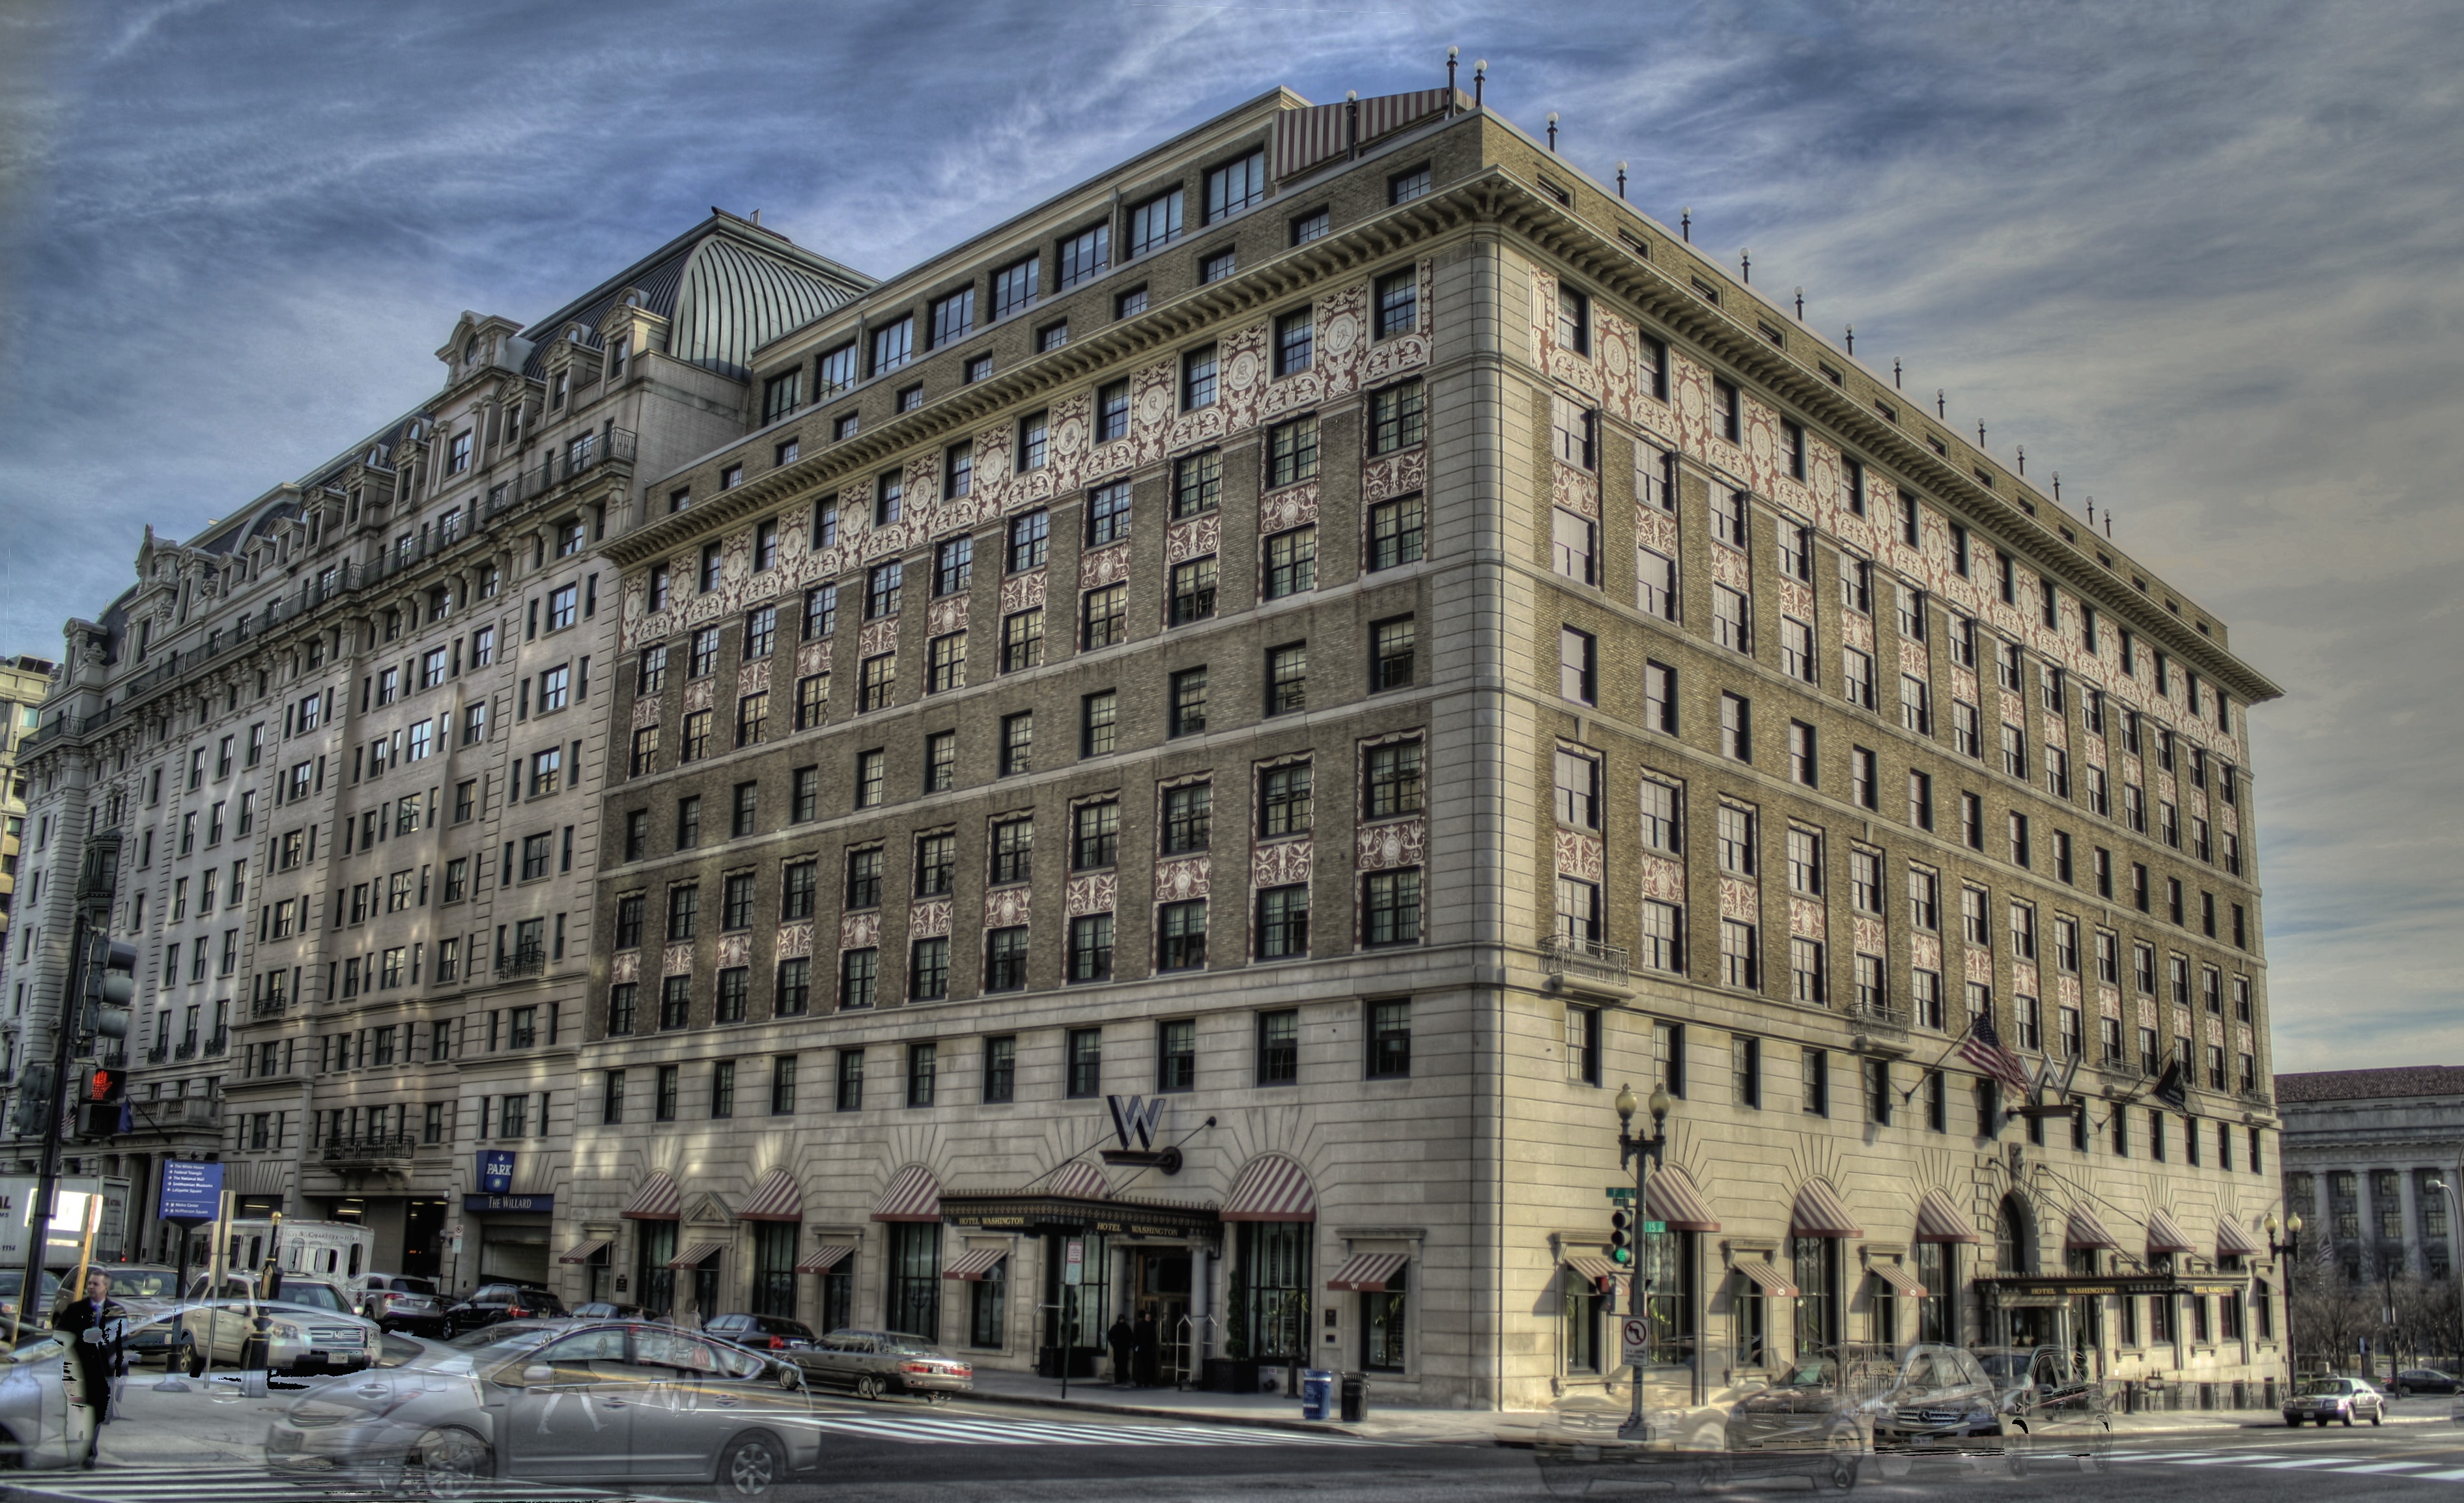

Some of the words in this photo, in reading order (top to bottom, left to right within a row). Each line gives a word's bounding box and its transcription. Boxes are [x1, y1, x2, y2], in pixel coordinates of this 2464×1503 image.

[2017, 1052, 2081, 1102] W
[1107, 1095, 1166, 1148] W
[487, 1163, 512, 1175] PARK
[1613, 1188, 1619, 1197] F
[489, 1196, 501, 1208] THE
[502, 1196, 531, 1209] WILLARD
[982, 1216, 1025, 1225] WASHINGTON
[1096, 1222, 1122, 1232] HOTEL
[1131, 1225, 1178, 1237] WASHINGTON
